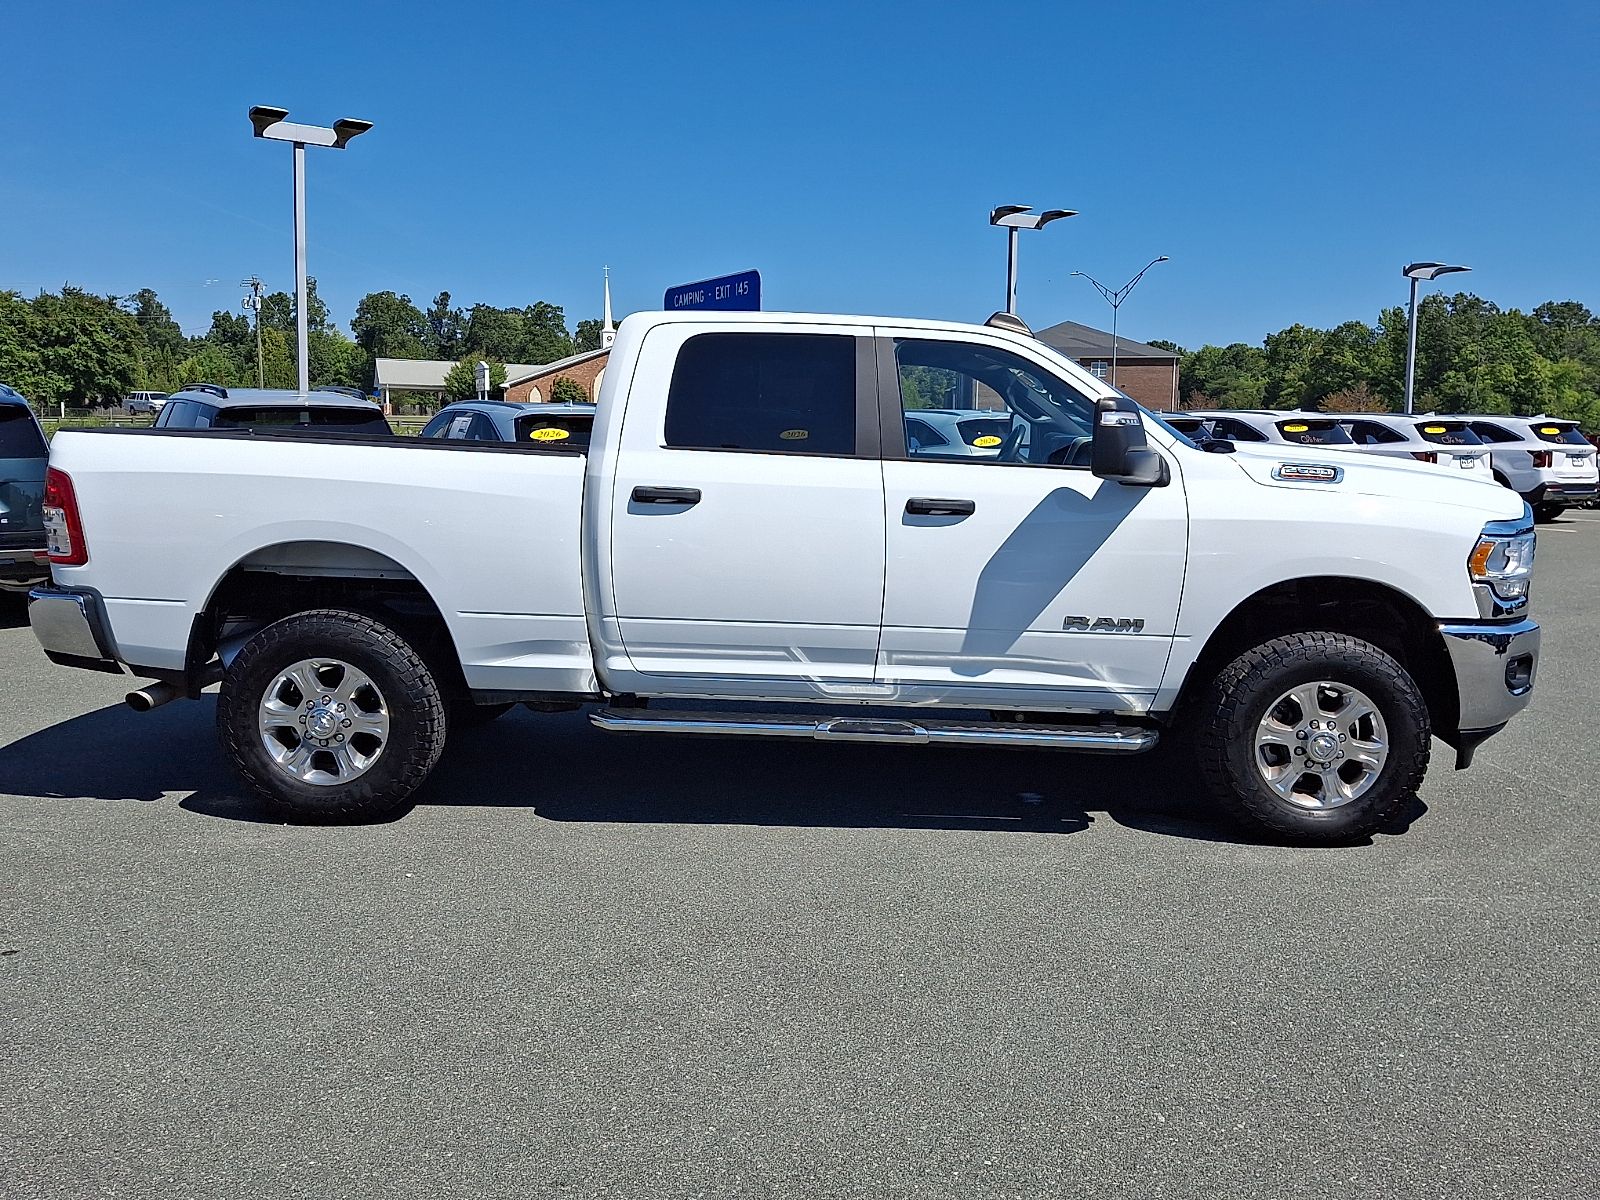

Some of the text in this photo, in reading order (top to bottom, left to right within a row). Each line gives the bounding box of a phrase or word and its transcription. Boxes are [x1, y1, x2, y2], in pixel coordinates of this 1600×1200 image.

[674, 290, 705, 308] CAMPING
[715, 284, 731, 300] EXIT
[735, 281, 749, 296] 145
[537, 430, 562, 439] 2026
[786, 431, 806, 439] 2026
[979, 438, 997, 446] 2026
[1062, 615, 1145, 634] RAM
